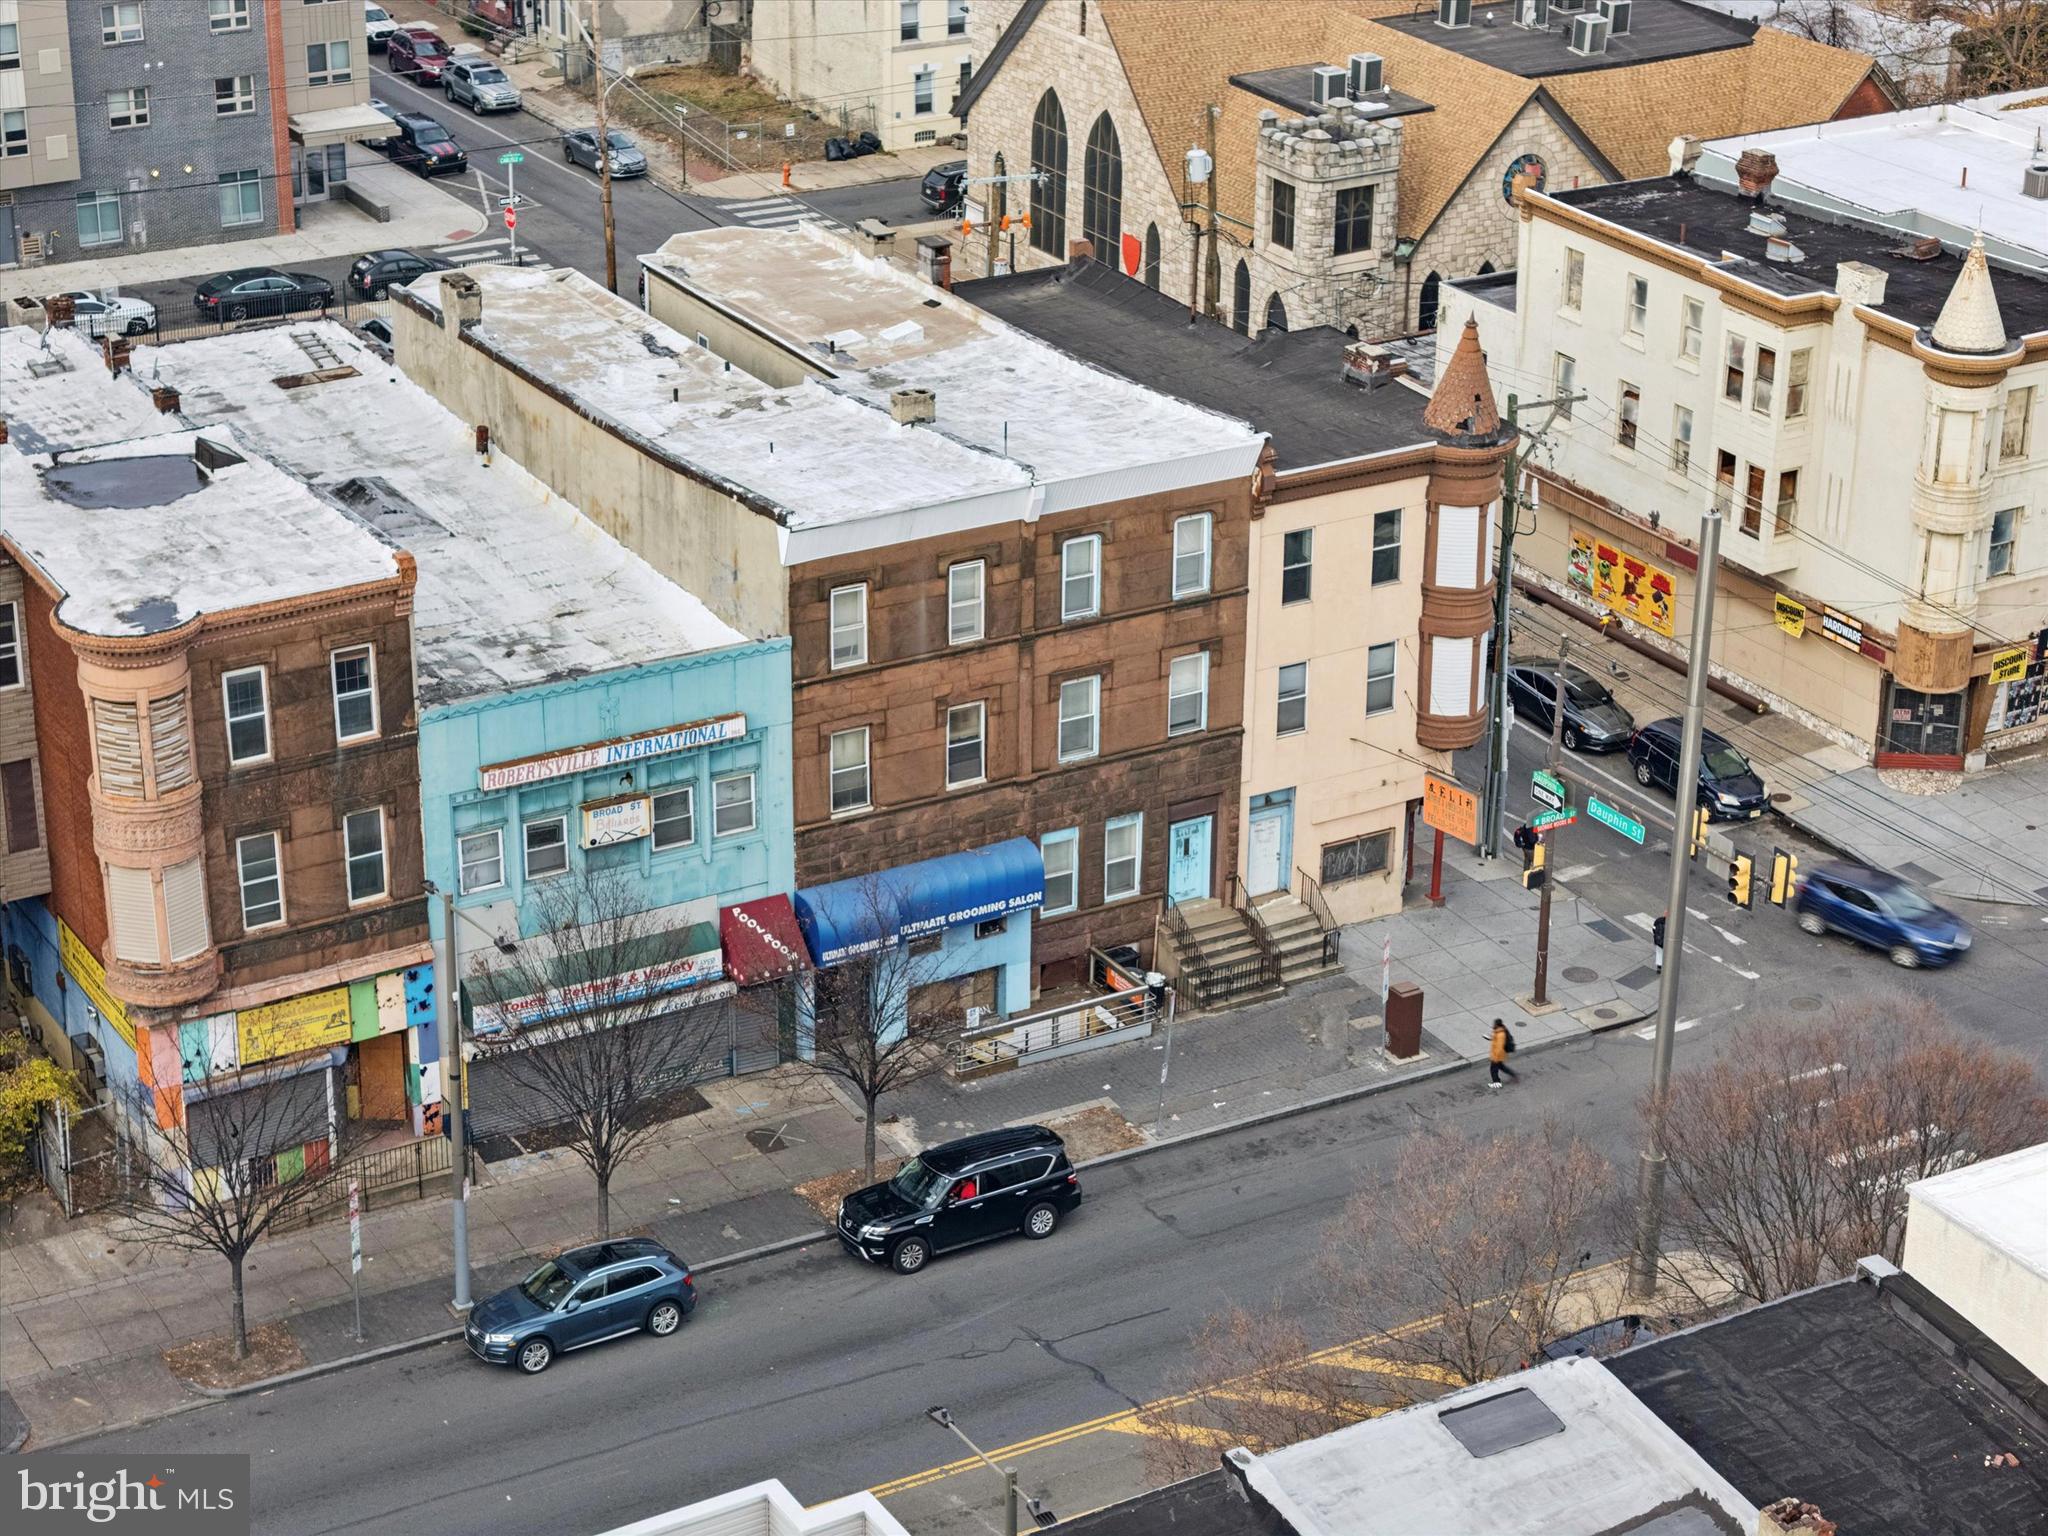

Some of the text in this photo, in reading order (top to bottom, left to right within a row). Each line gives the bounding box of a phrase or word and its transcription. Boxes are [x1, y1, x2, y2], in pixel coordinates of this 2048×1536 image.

[1823, 615, 1862, 644] HARDWARE
[1993, 651, 2028, 671] DISCOUNT
[1998, 667, 2021, 680] STORE
[486, 749, 600, 789] ROBERTSVILLE
[606, 722, 728, 763] INTERNATIONAL
[592, 805, 624, 819] BROAD
[1541, 812, 1566, 825] BROAD
[1591, 802, 1642, 839] Dauphin St
[732, 907, 766, 934] POOL
[900, 915, 947, 936] ULTIMATE
[948, 902, 1006, 924] GROOMING
[1008, 890, 1043, 909] SALON
[643, 958, 695, 981] Variety
